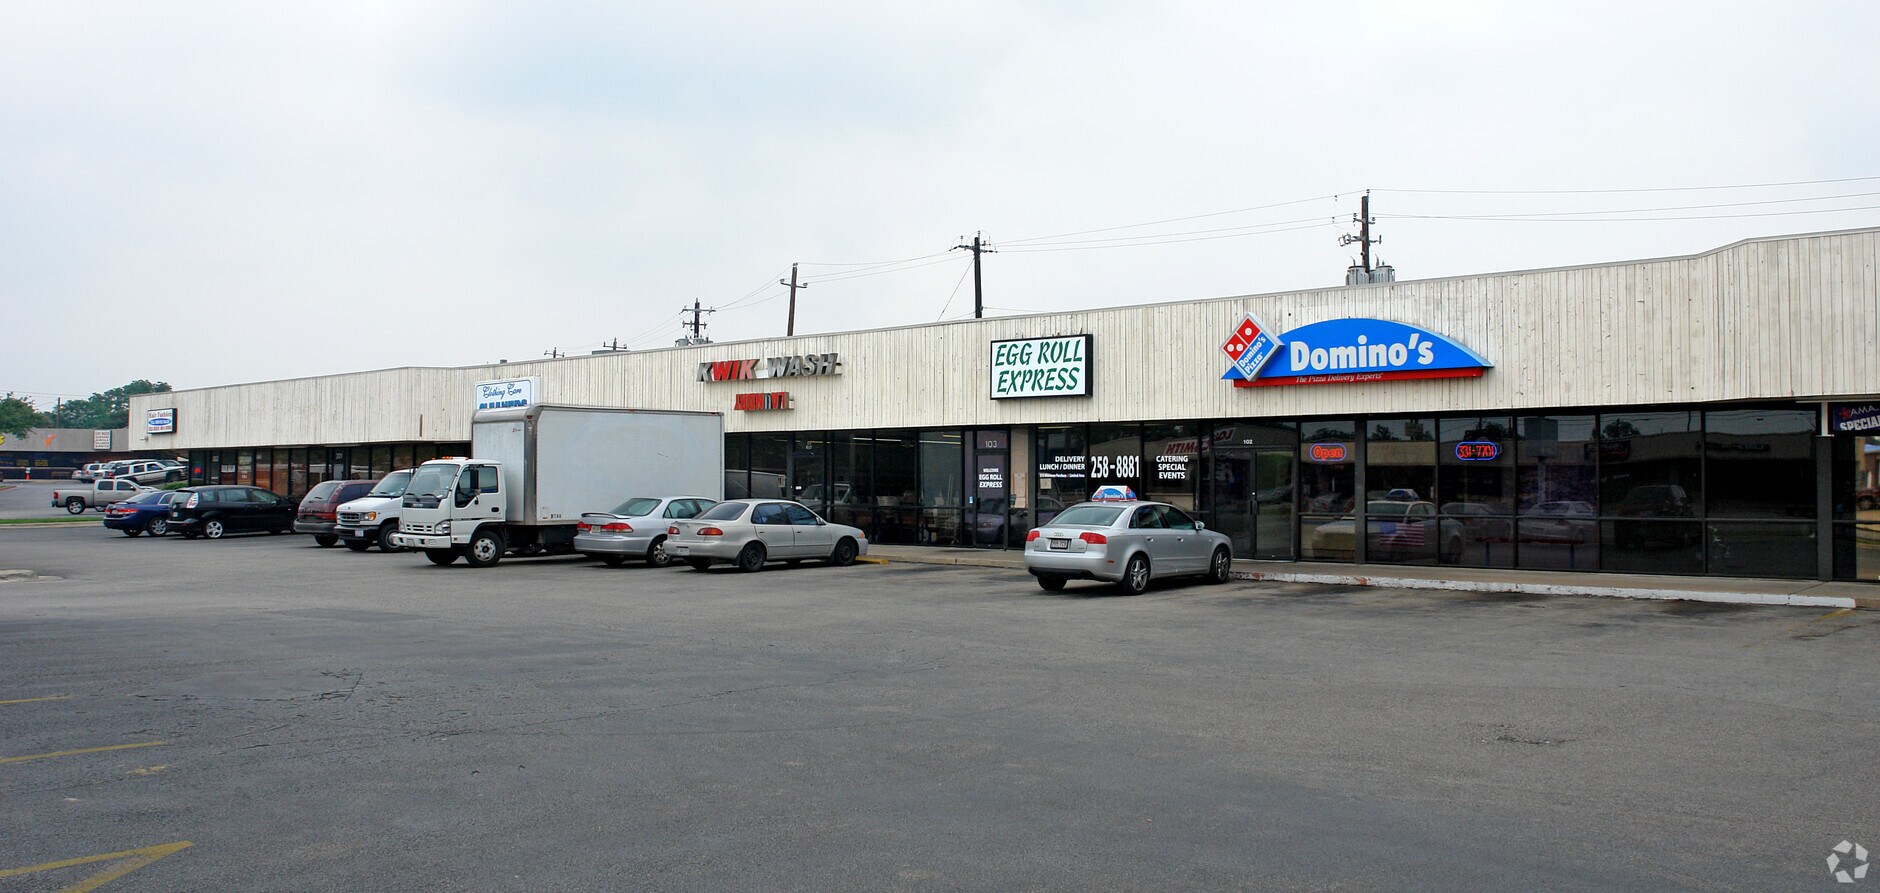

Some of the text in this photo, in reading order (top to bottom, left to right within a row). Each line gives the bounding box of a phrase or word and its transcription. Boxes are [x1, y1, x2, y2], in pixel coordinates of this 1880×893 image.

[995, 339, 1083, 366] EGG ROLL
[1239, 335, 1266, 367] Domino's
[1290, 333, 1434, 371] Domino's
[697, 353, 837, 382] KWIK WASH
[1244, 353, 1263, 374] Pizza
[997, 367, 1080, 395] EXPRESS
[1328, 374, 1354, 382] Delivery
[1356, 373, 1382, 381] Experts
[1156, 455, 1188, 463] CATERING
[1313, 445, 1343, 460] Open
[1091, 455, 1139, 478] 258-8881
[1158, 463, 1186, 471] SPECIAL
